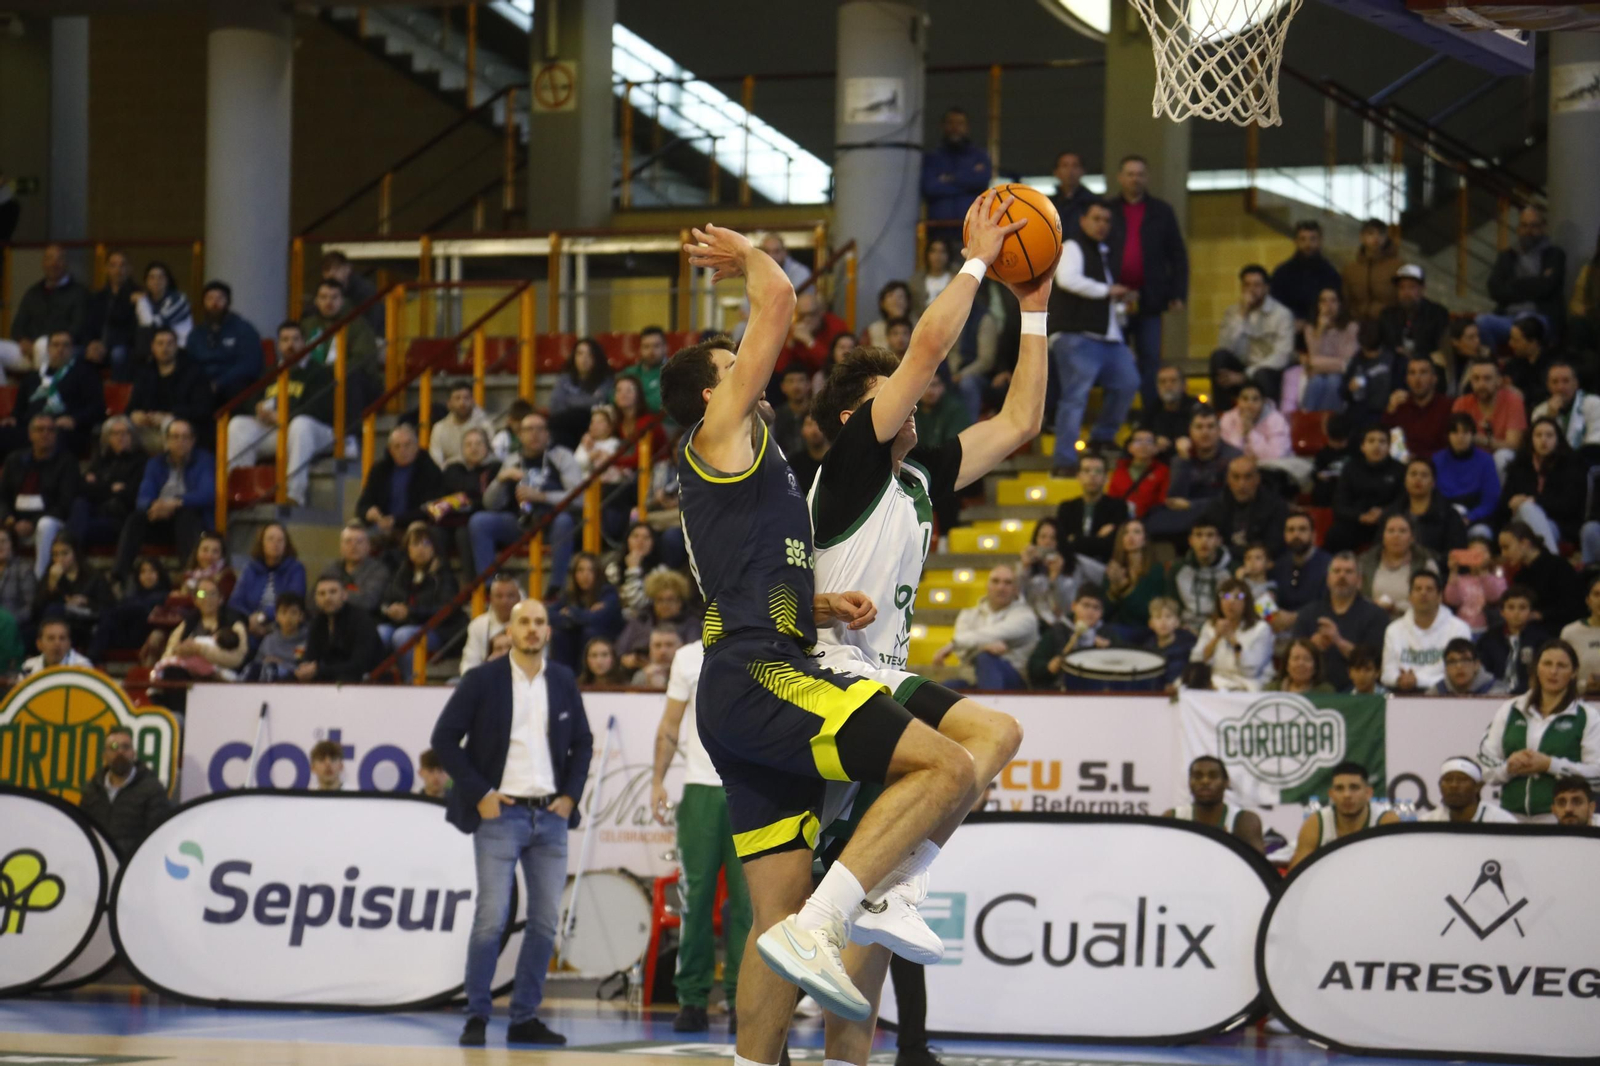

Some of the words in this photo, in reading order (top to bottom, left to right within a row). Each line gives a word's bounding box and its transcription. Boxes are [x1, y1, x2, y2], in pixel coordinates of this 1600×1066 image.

[1223, 721, 1334, 758] CORDOBA
[1032, 794, 1150, 816] Reformas
[202, 859, 472, 947] Sepisur
[974, 892, 1216, 969] Cualix
[1317, 960, 1600, 999] ATRESVEG
